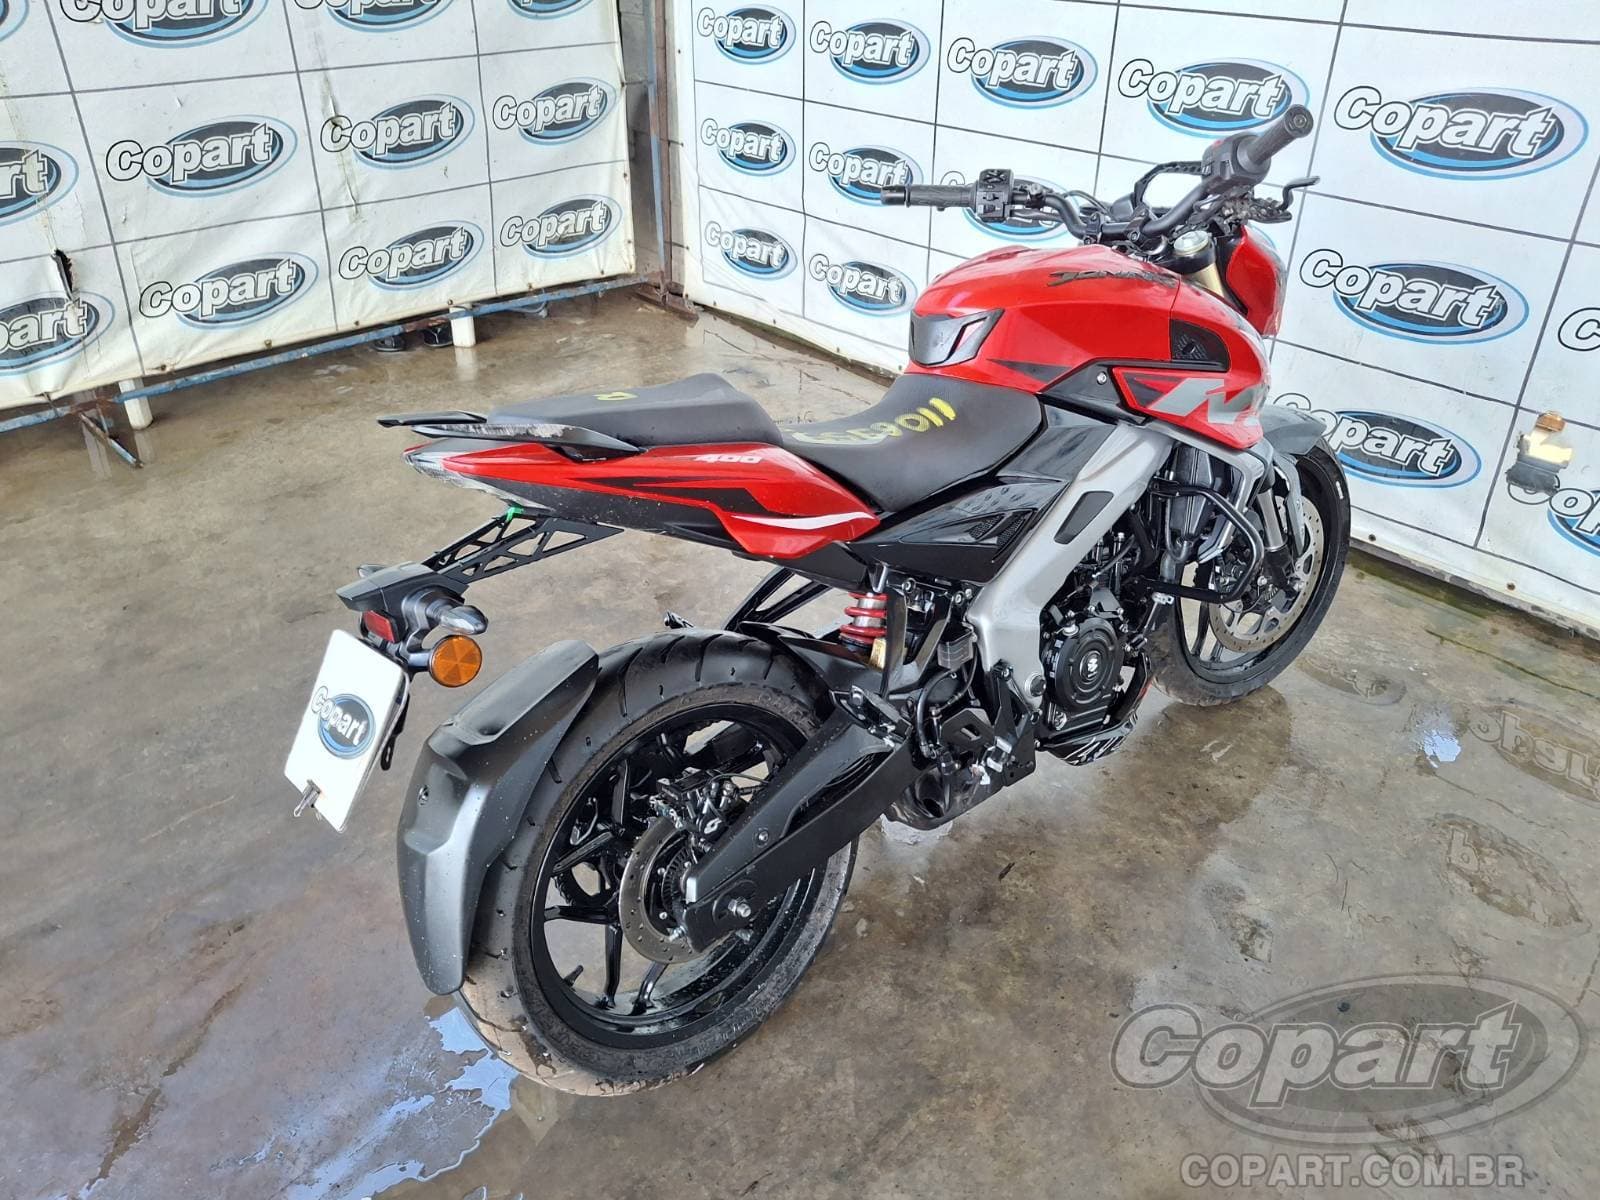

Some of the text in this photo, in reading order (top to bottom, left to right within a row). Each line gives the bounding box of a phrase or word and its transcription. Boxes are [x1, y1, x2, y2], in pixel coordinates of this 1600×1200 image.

[697, 7, 784, 49] Copart
[810, 21, 915, 66] Copart
[947, 37, 1077, 90] Copart
[1117, 58, 1286, 117] Copart
[320, 102, 456, 156] Copart
[493, 84, 603, 135] Copart
[1333, 85, 1557, 158] Copart
[106, 122, 273, 186] Copart
[700, 118, 784, 162] Copart
[809, 142, 909, 188] Copart
[500, 201, 608, 249] Copart
[704, 221, 787, 269] Copart
[339, 226, 468, 281] Copart
[809, 254, 904, 304] Copart
[139, 257, 297, 319] Copart
[1300, 248, 1498, 328] Copart
[694, 453, 763, 464] 400
[311, 685, 368, 747] Copart
